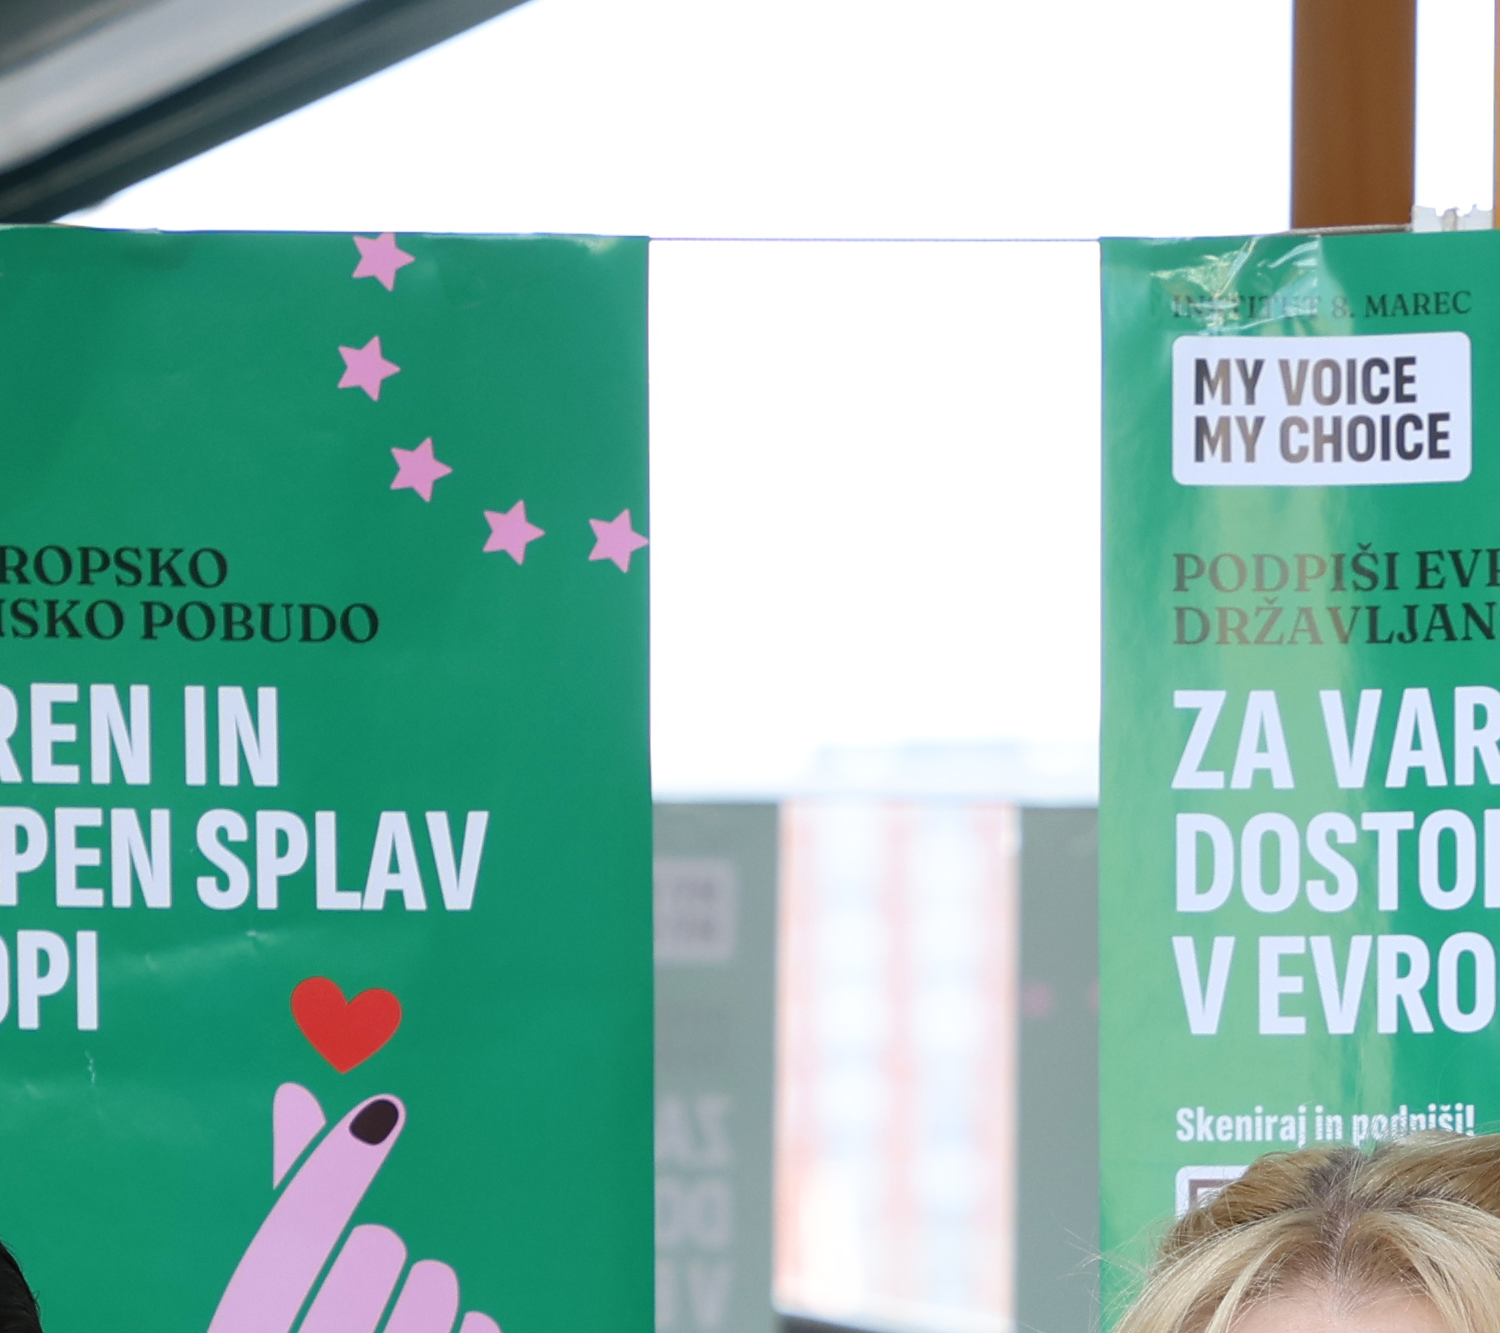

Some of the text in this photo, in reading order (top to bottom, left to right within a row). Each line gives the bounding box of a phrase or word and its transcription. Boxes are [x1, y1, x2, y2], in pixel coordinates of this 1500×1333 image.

[1331, 296, 1356, 320] 8.
[1365, 290, 1472, 319] MAREC
[1194, 356, 1417, 406] MY VOICE
[1194, 413, 1451, 465] MY CHOICE
[1172, 542, 1399, 594] PODPIŠI
[140, 602, 380, 645] POBUDO
[185, 685, 279, 788] IN
[1171, 690, 1295, 791] ZA
[196, 809, 491, 913] SPLAV
[1172, 936, 1236, 1036] V
[1175, 1105, 1307, 1148] Skeniraj
[1314, 1105, 1343, 1141] in
